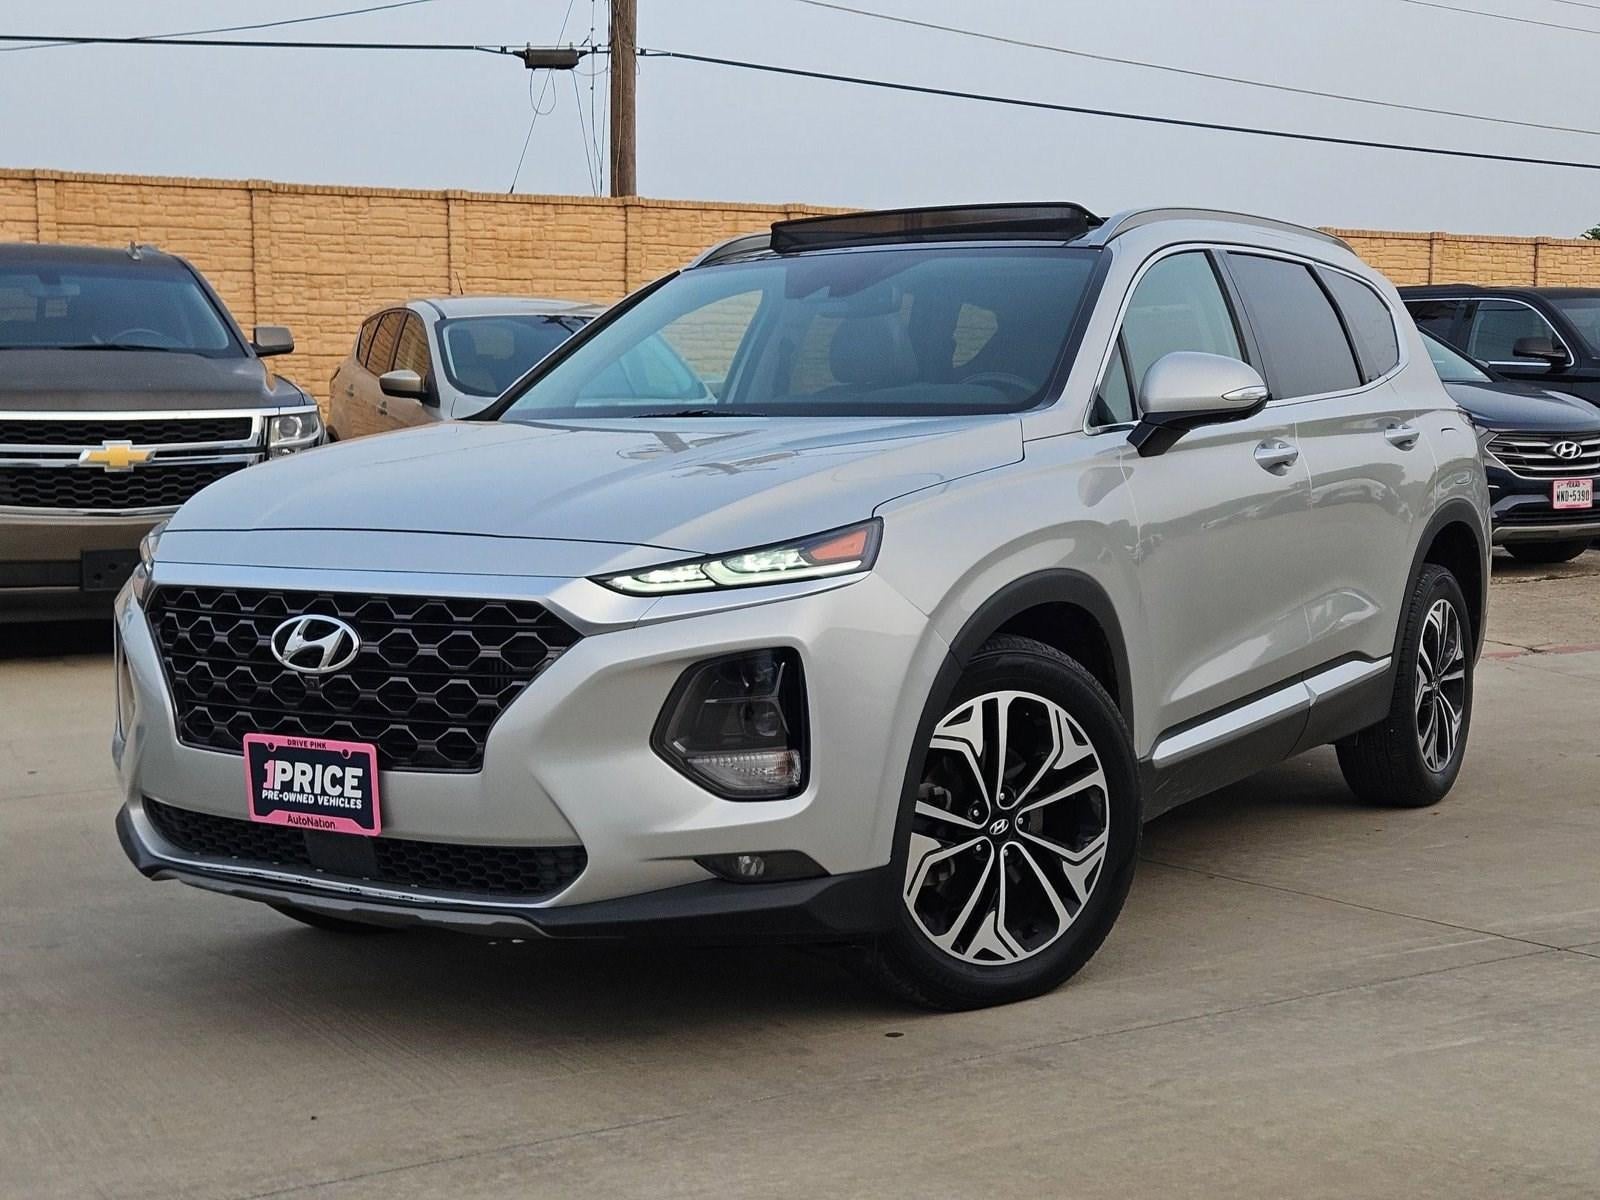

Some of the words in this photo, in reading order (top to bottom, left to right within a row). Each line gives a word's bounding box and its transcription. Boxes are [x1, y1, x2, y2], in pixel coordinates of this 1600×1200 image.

[287, 738, 308, 748] DRIVE
[310, 741, 327, 749] PINK
[262, 759, 363, 798] 1PRICE
[261, 789, 315, 805] PRE-OWNED
[317, 795, 362, 809] VEHICLES
[287, 813, 336, 829] AutoNation
